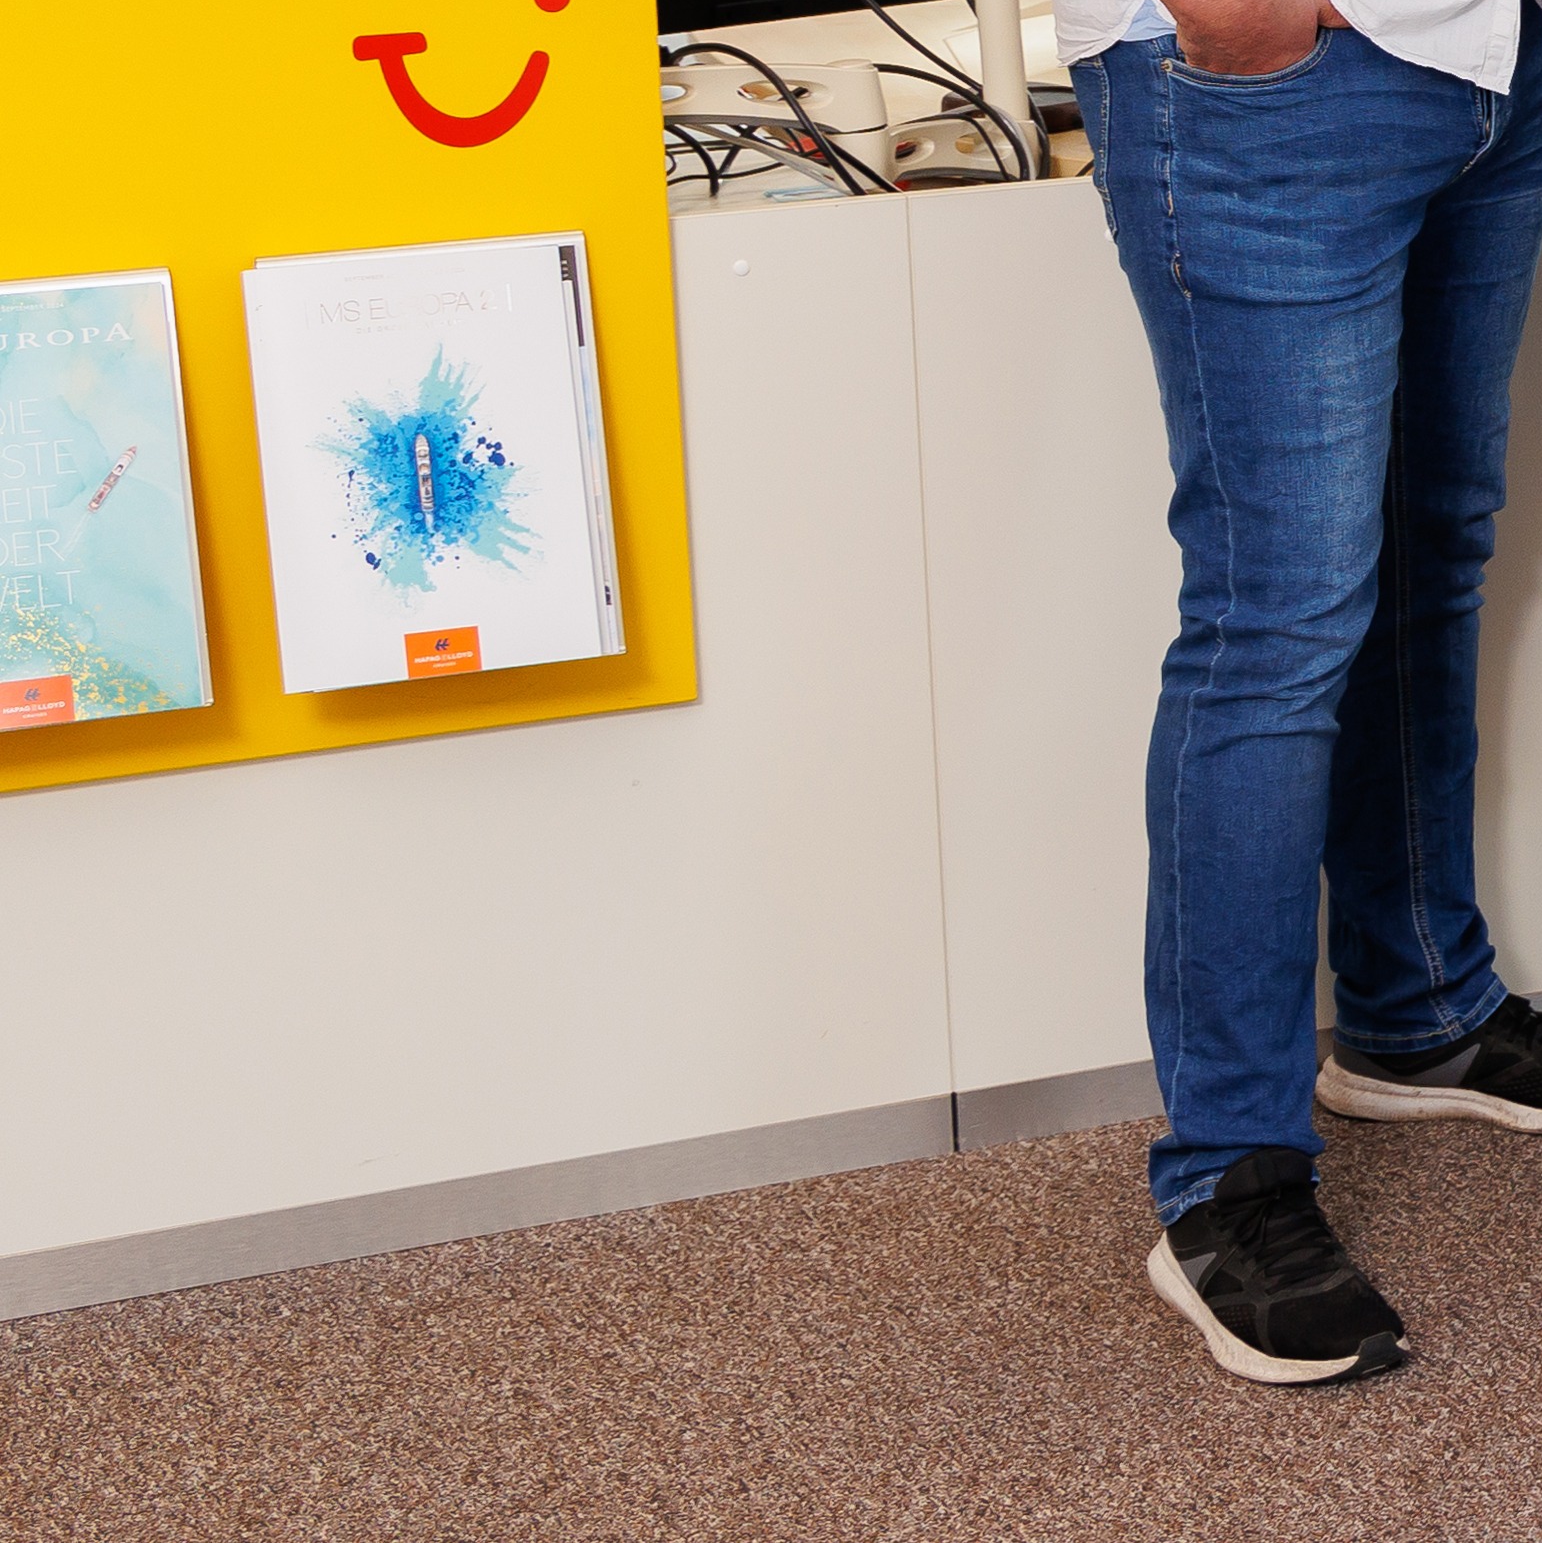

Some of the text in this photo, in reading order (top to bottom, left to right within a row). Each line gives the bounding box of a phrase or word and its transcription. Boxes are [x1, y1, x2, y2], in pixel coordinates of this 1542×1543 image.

[319, 299, 361, 325] MS
[368, 290, 474, 321] EUOPA
[0, 484, 57, 525] EIT
[0, 570, 81, 610] ELT
